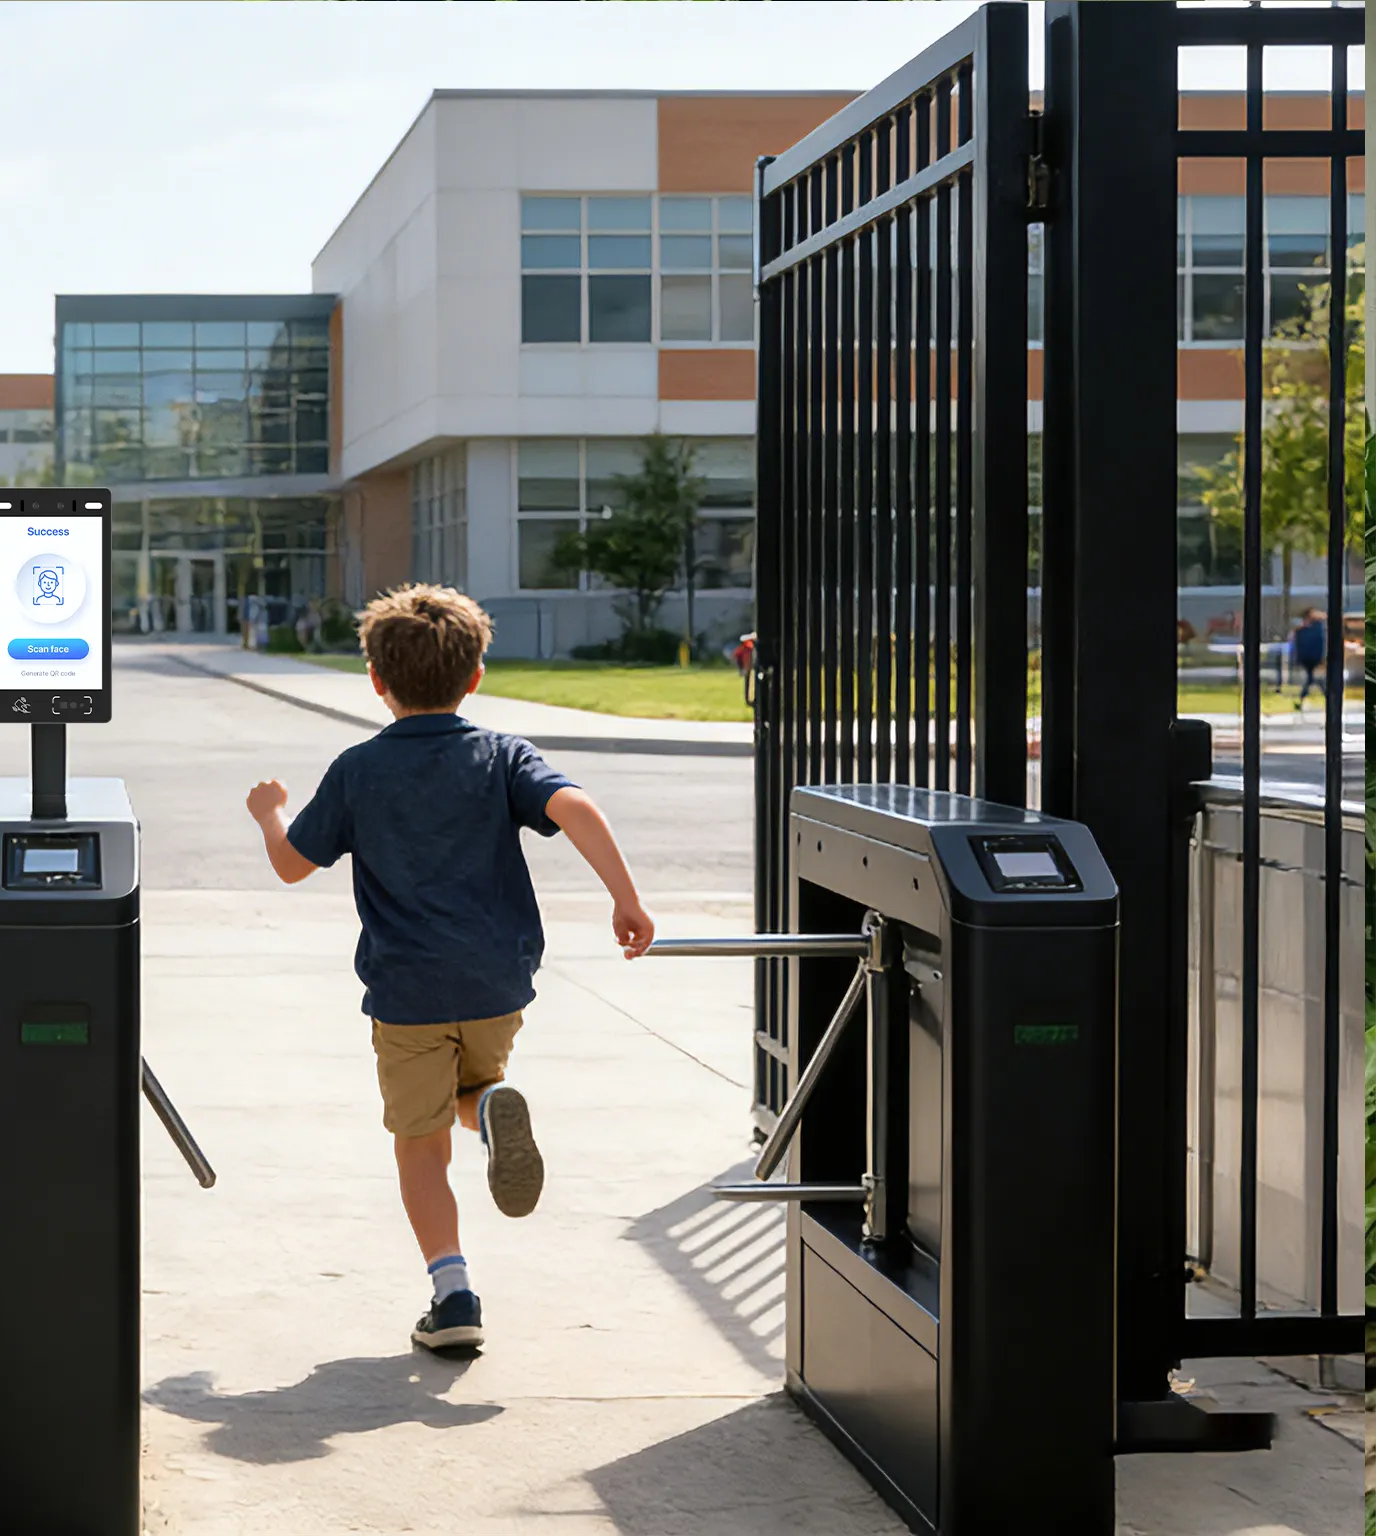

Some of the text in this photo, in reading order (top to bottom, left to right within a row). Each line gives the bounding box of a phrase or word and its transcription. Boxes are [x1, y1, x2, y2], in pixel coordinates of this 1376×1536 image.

[27, 527, 70, 537] Success
[27, 645, 69, 653] Scan face
